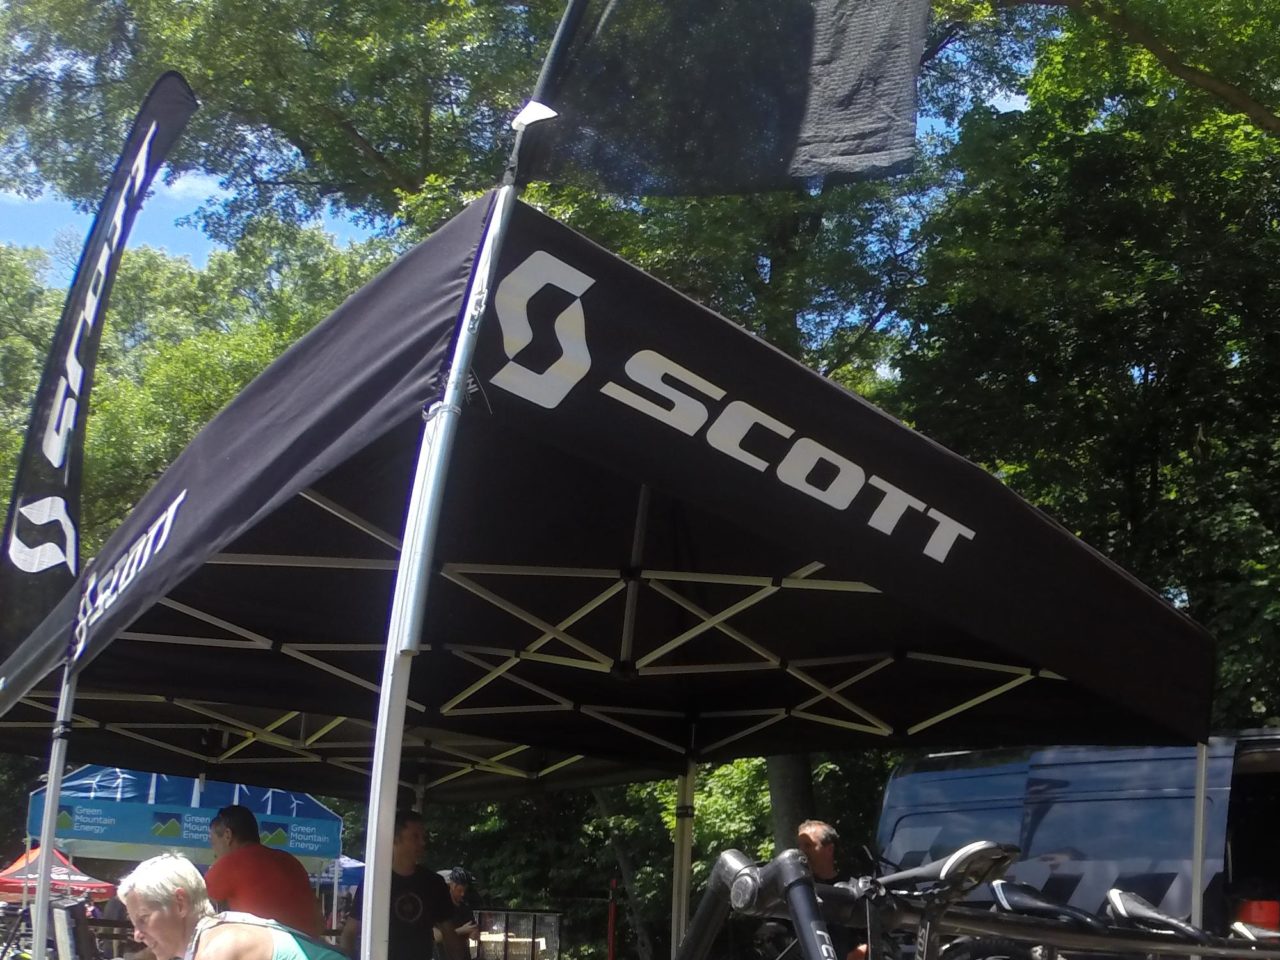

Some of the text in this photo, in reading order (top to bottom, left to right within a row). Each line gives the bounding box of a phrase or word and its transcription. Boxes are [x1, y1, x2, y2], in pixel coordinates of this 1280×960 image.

[600, 349, 977, 564] SCOTT
[87, 488, 188, 628] SCOTT
[74, 806, 103, 816] Green
[74, 814, 116, 825] Mountain
[184, 814, 211, 824] Green
[73, 823, 105, 834] Energy
[291, 824, 316, 834] Green
[182, 830, 209, 841] Energ
[290, 832, 330, 844] Mountain
[289, 840, 321, 851] Energy
